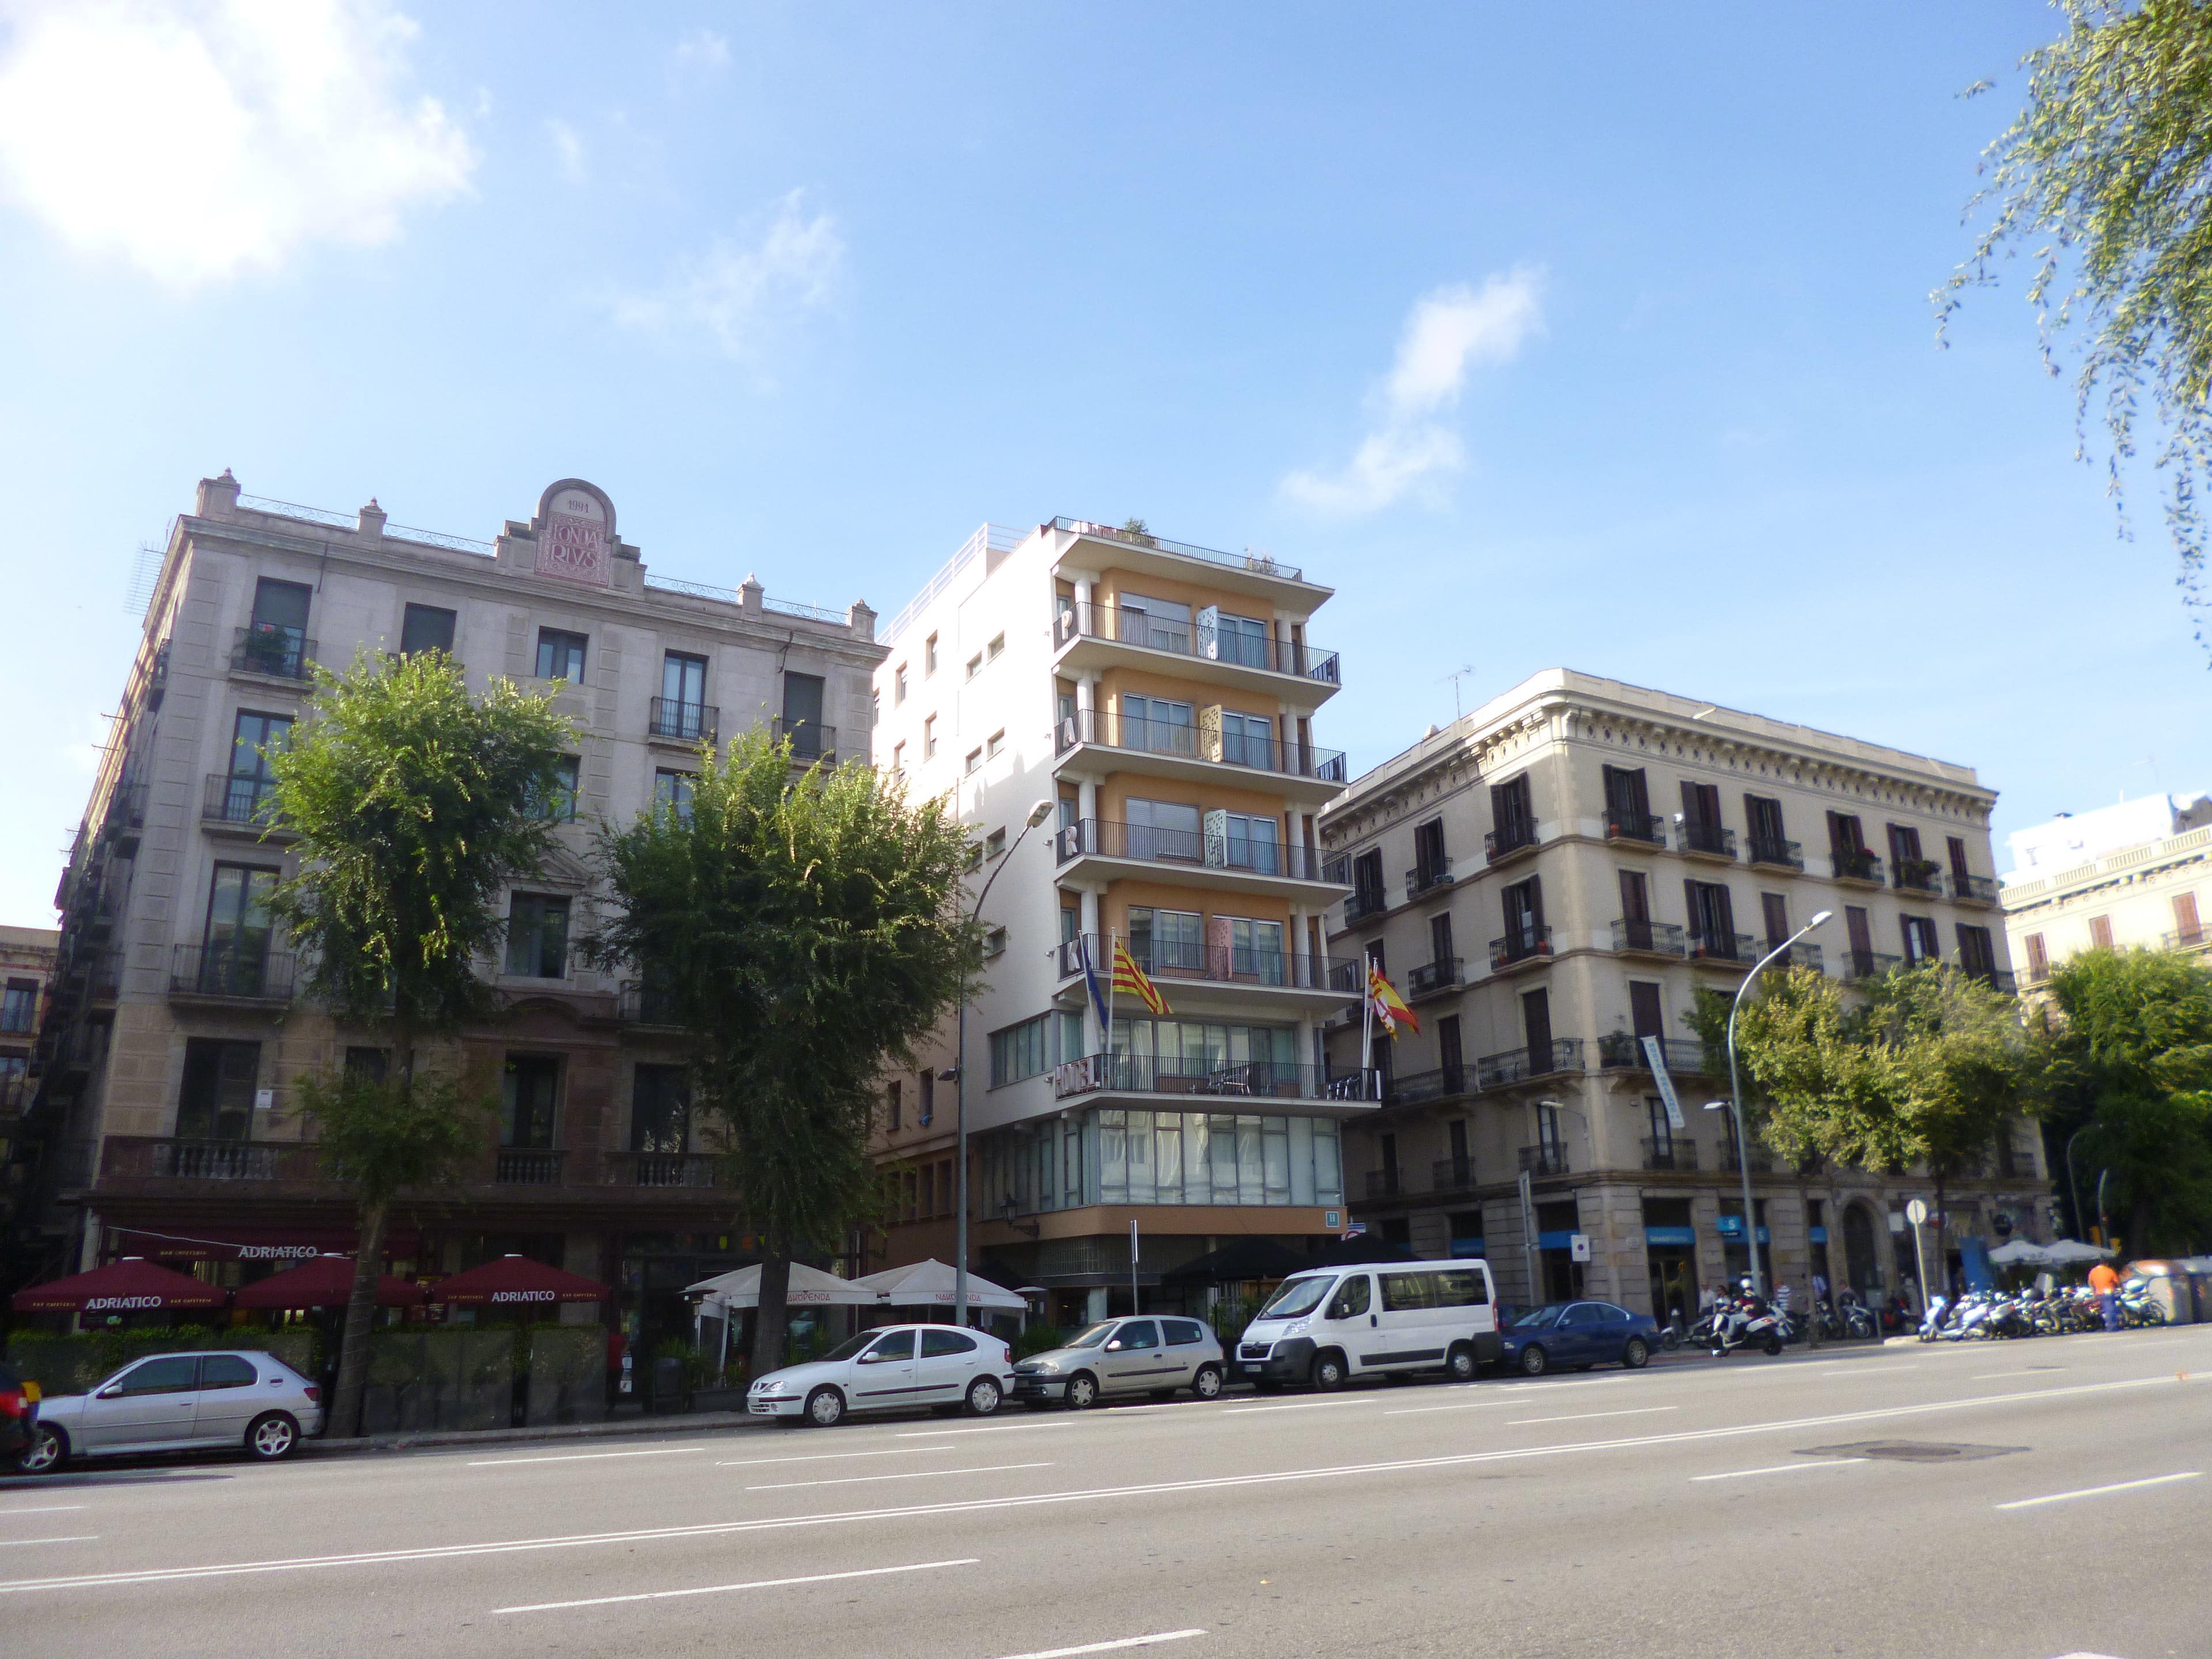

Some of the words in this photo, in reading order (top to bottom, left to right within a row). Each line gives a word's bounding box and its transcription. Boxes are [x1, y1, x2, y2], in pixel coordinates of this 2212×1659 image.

[554, 524, 598, 548] FONDA
[1055, 1057, 1097, 1098] HOTEL
[1330, 1214, 1335, 1222] H
[238, 1245, 317, 1259] ADRIATICO
[491, 1290, 555, 1302] ADRIATICO
[787, 1293, 830, 1301] AKOPENDA
[935, 1293, 982, 1301] NAKONDA
[86, 1296, 162, 1309] ADRIATICO
